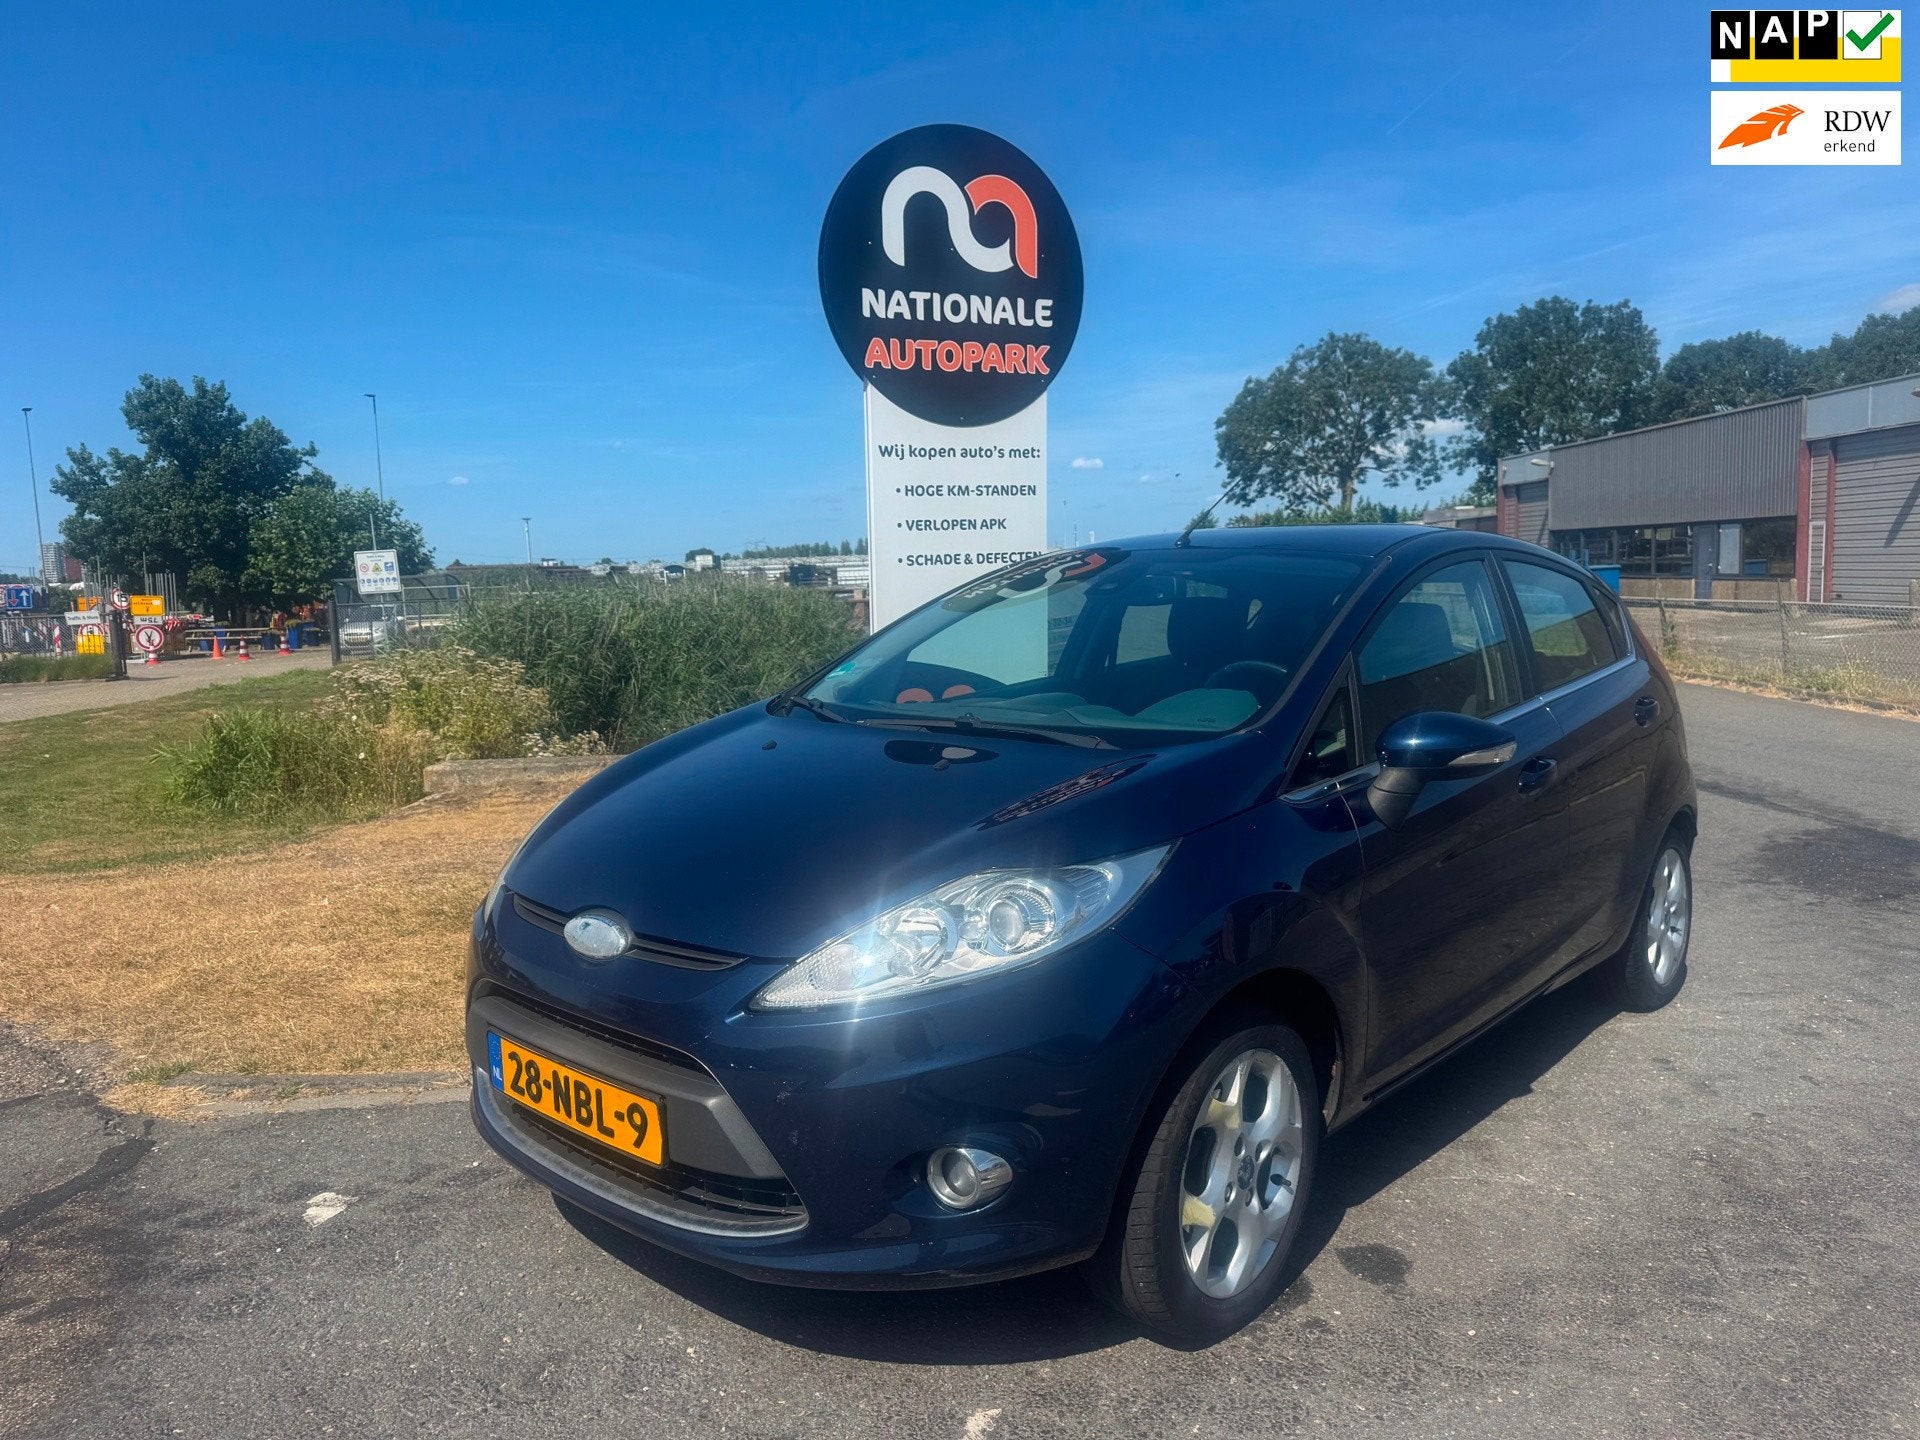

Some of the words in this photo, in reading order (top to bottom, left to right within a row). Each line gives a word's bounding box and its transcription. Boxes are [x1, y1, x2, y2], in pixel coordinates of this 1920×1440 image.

[861, 287, 1054, 328] NATIONALE
[864, 337, 1050, 375] AUTOPARK
[878, 444, 904, 460] Wij
[909, 445, 956, 460] kopen
[960, 445, 1005, 459] auto's
[1008, 446, 1041, 459] met:
[904, 484, 944, 497] HOGE
[947, 484, 1037, 497] KM-STANDEN
[905, 519, 977, 531] VERLOPEN
[979, 518, 1007, 530] APK
[906, 553, 961, 567] SCHADE
[963, 553, 973, 565] &
[508, 1051, 648, 1149] 28-NBL-9
